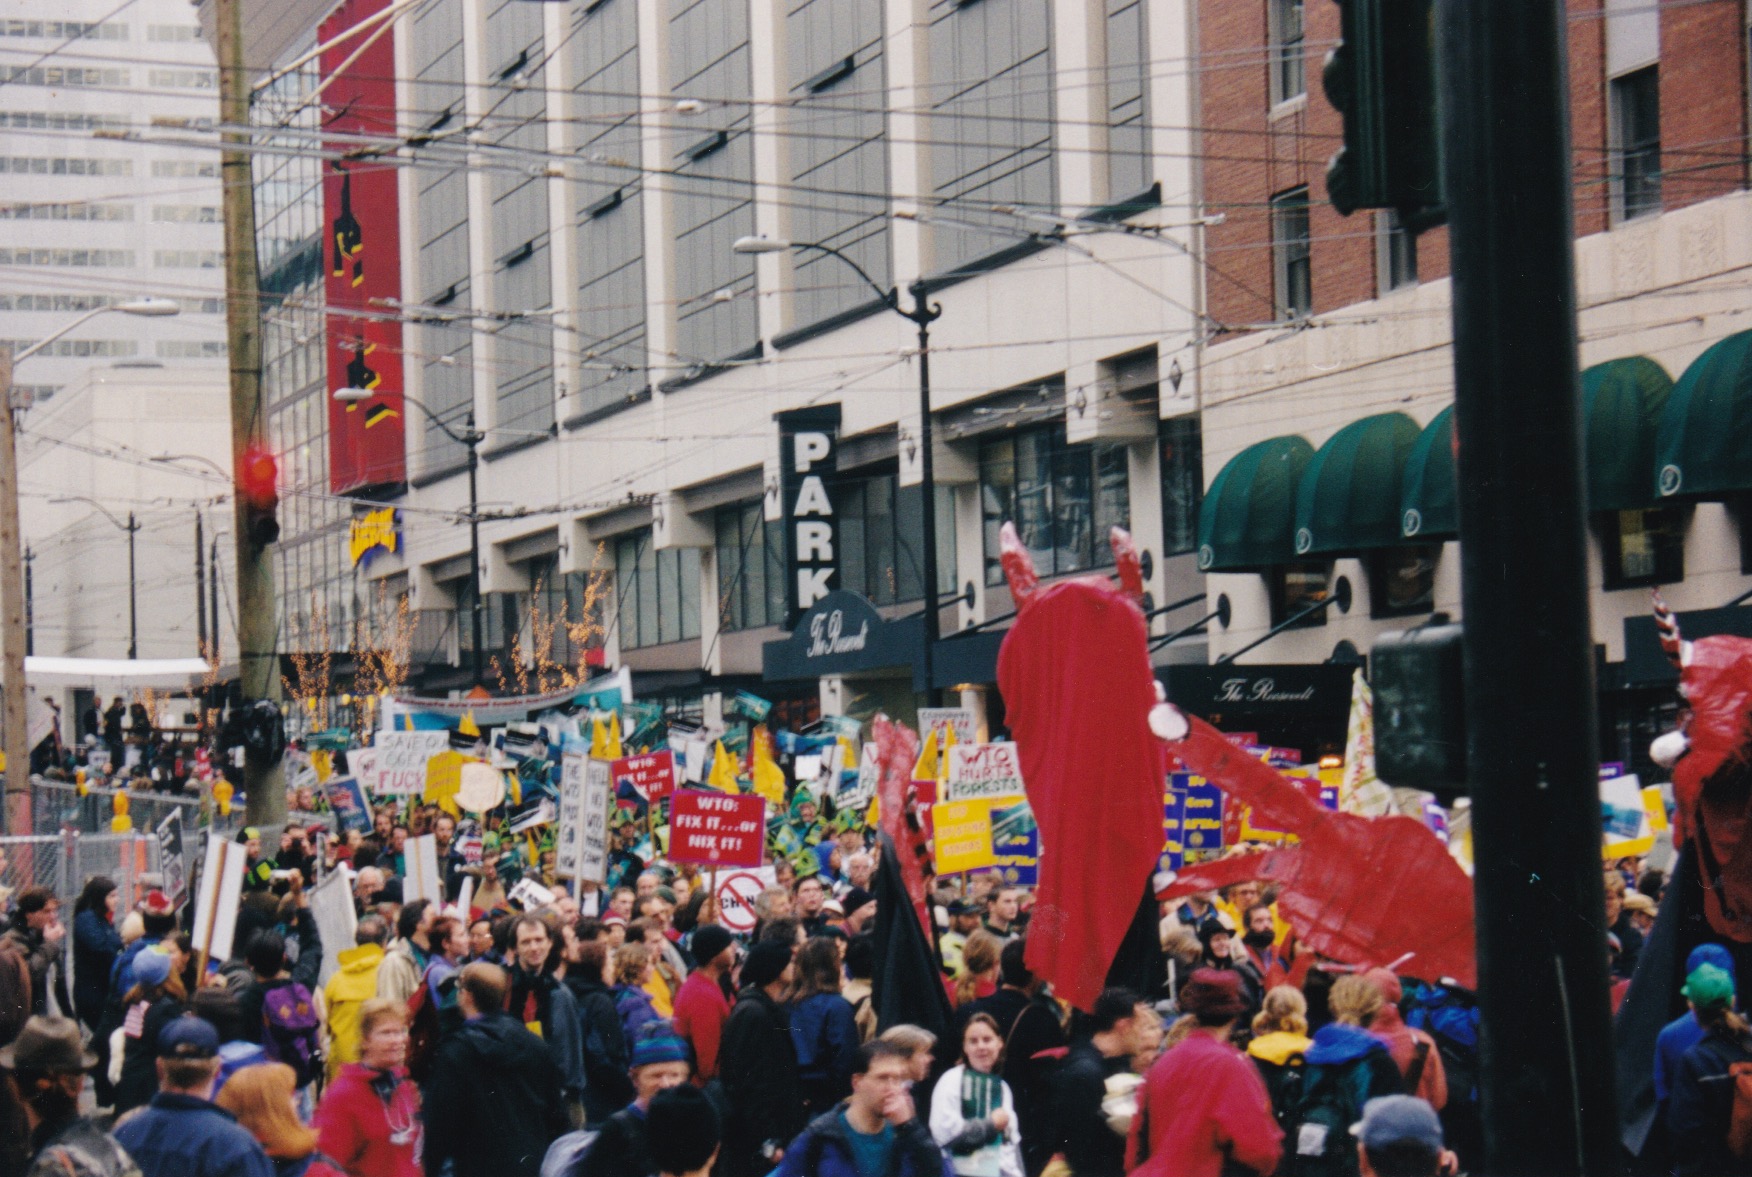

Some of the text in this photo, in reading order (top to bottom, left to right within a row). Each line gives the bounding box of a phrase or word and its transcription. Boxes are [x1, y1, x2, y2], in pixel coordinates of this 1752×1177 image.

[793, 432, 835, 609] PARK
[807, 612, 827, 657] The
[1214, 677, 1315, 701] The Roosevelt
[383, 735, 421, 748] SAVE
[386, 751, 426, 767] OCEA
[628, 757, 656, 770] WTO:
[960, 746, 1008, 764] WTO
[960, 762, 1013, 779] HURTS
[953, 778, 1017, 797] FORESTS
[697, 796, 739, 812] WTO:
[676, 814, 702, 829] FIX
[689, 834, 743, 851] NIX IT!
